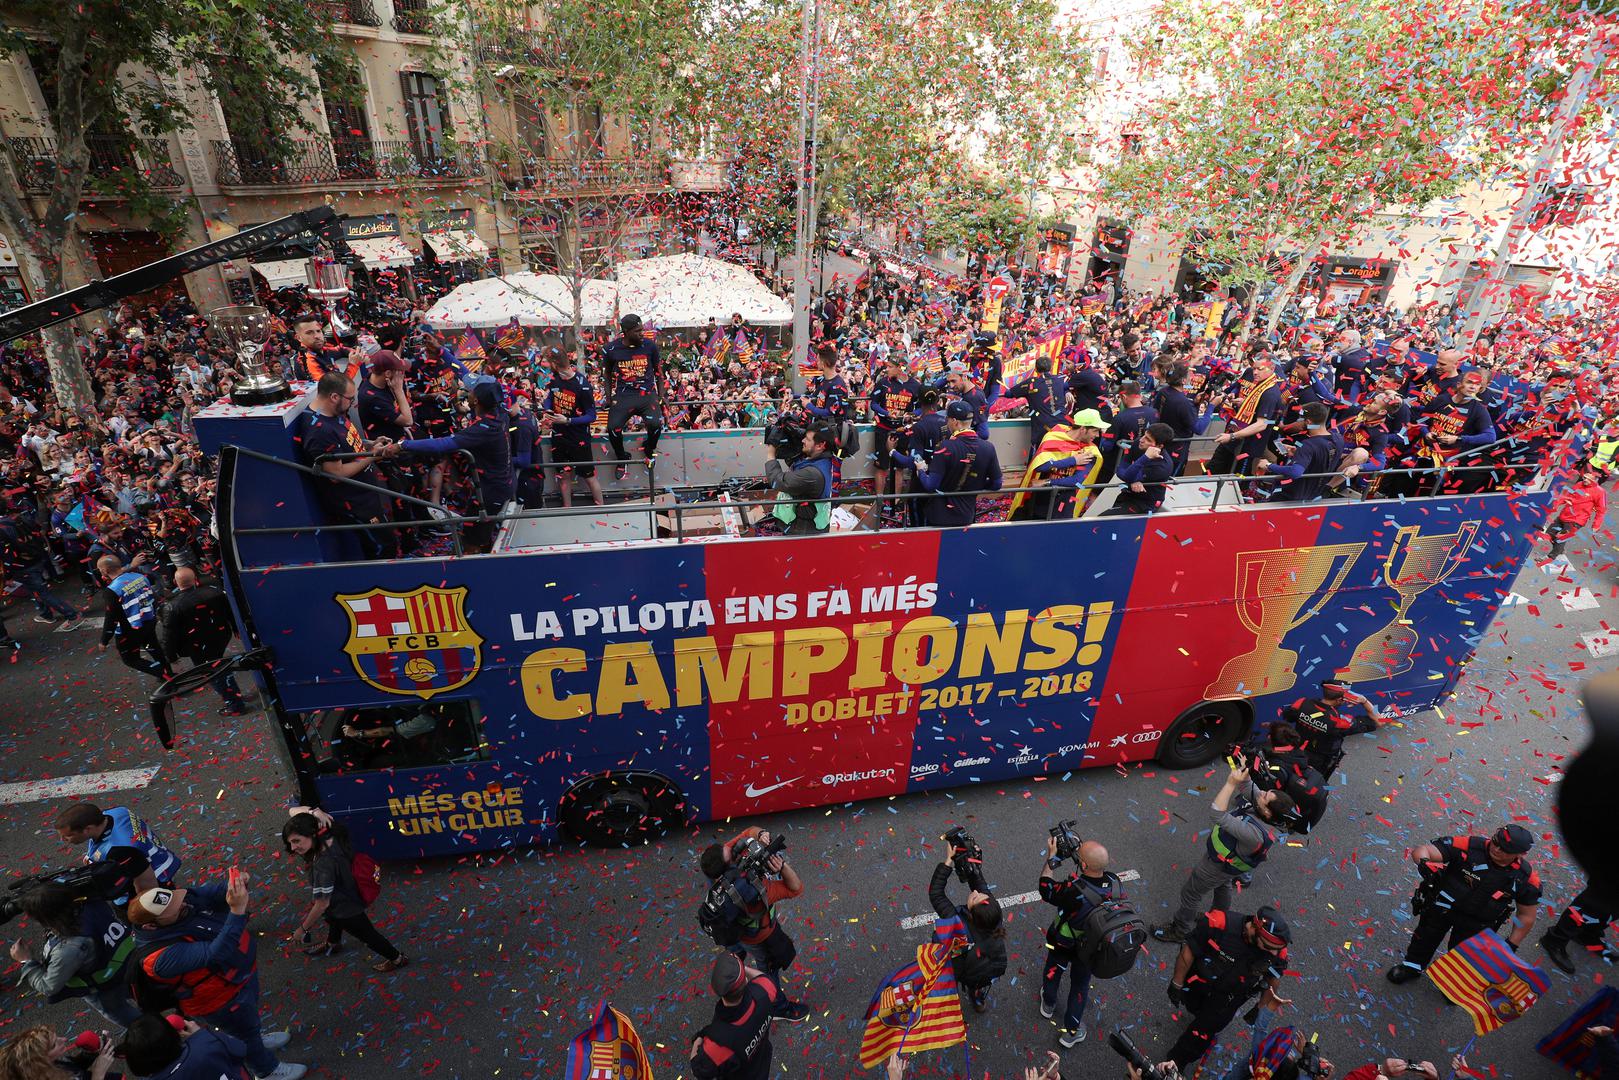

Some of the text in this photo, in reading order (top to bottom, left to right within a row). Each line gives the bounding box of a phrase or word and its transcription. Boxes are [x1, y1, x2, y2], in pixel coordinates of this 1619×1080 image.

[510, 575, 938, 641] LA PILOTA ENS FA MÉS
[387, 634, 440, 651] FCB
[520, 601, 1115, 721] CAMPIONS!
[786, 690, 915, 726] DOBLET
[919, 682, 994, 711] 2017
[1021, 671, 1094, 699] 2018
[1299, 712, 1328, 731] POLICIA
[1379, 706, 1420, 720] MONUS
[1058, 741, 1100, 753] KONAMI
[910, 762, 939, 774] beko
[953, 756, 991, 768] Gillette
[1007, 754, 1039, 764] ESTRELLA
[388, 787, 524, 816] MÉS QUE
[398, 808, 524, 836] UN CLUB
[103, 919, 128, 948] 10
[744, 1015, 772, 1056] POLICIA
